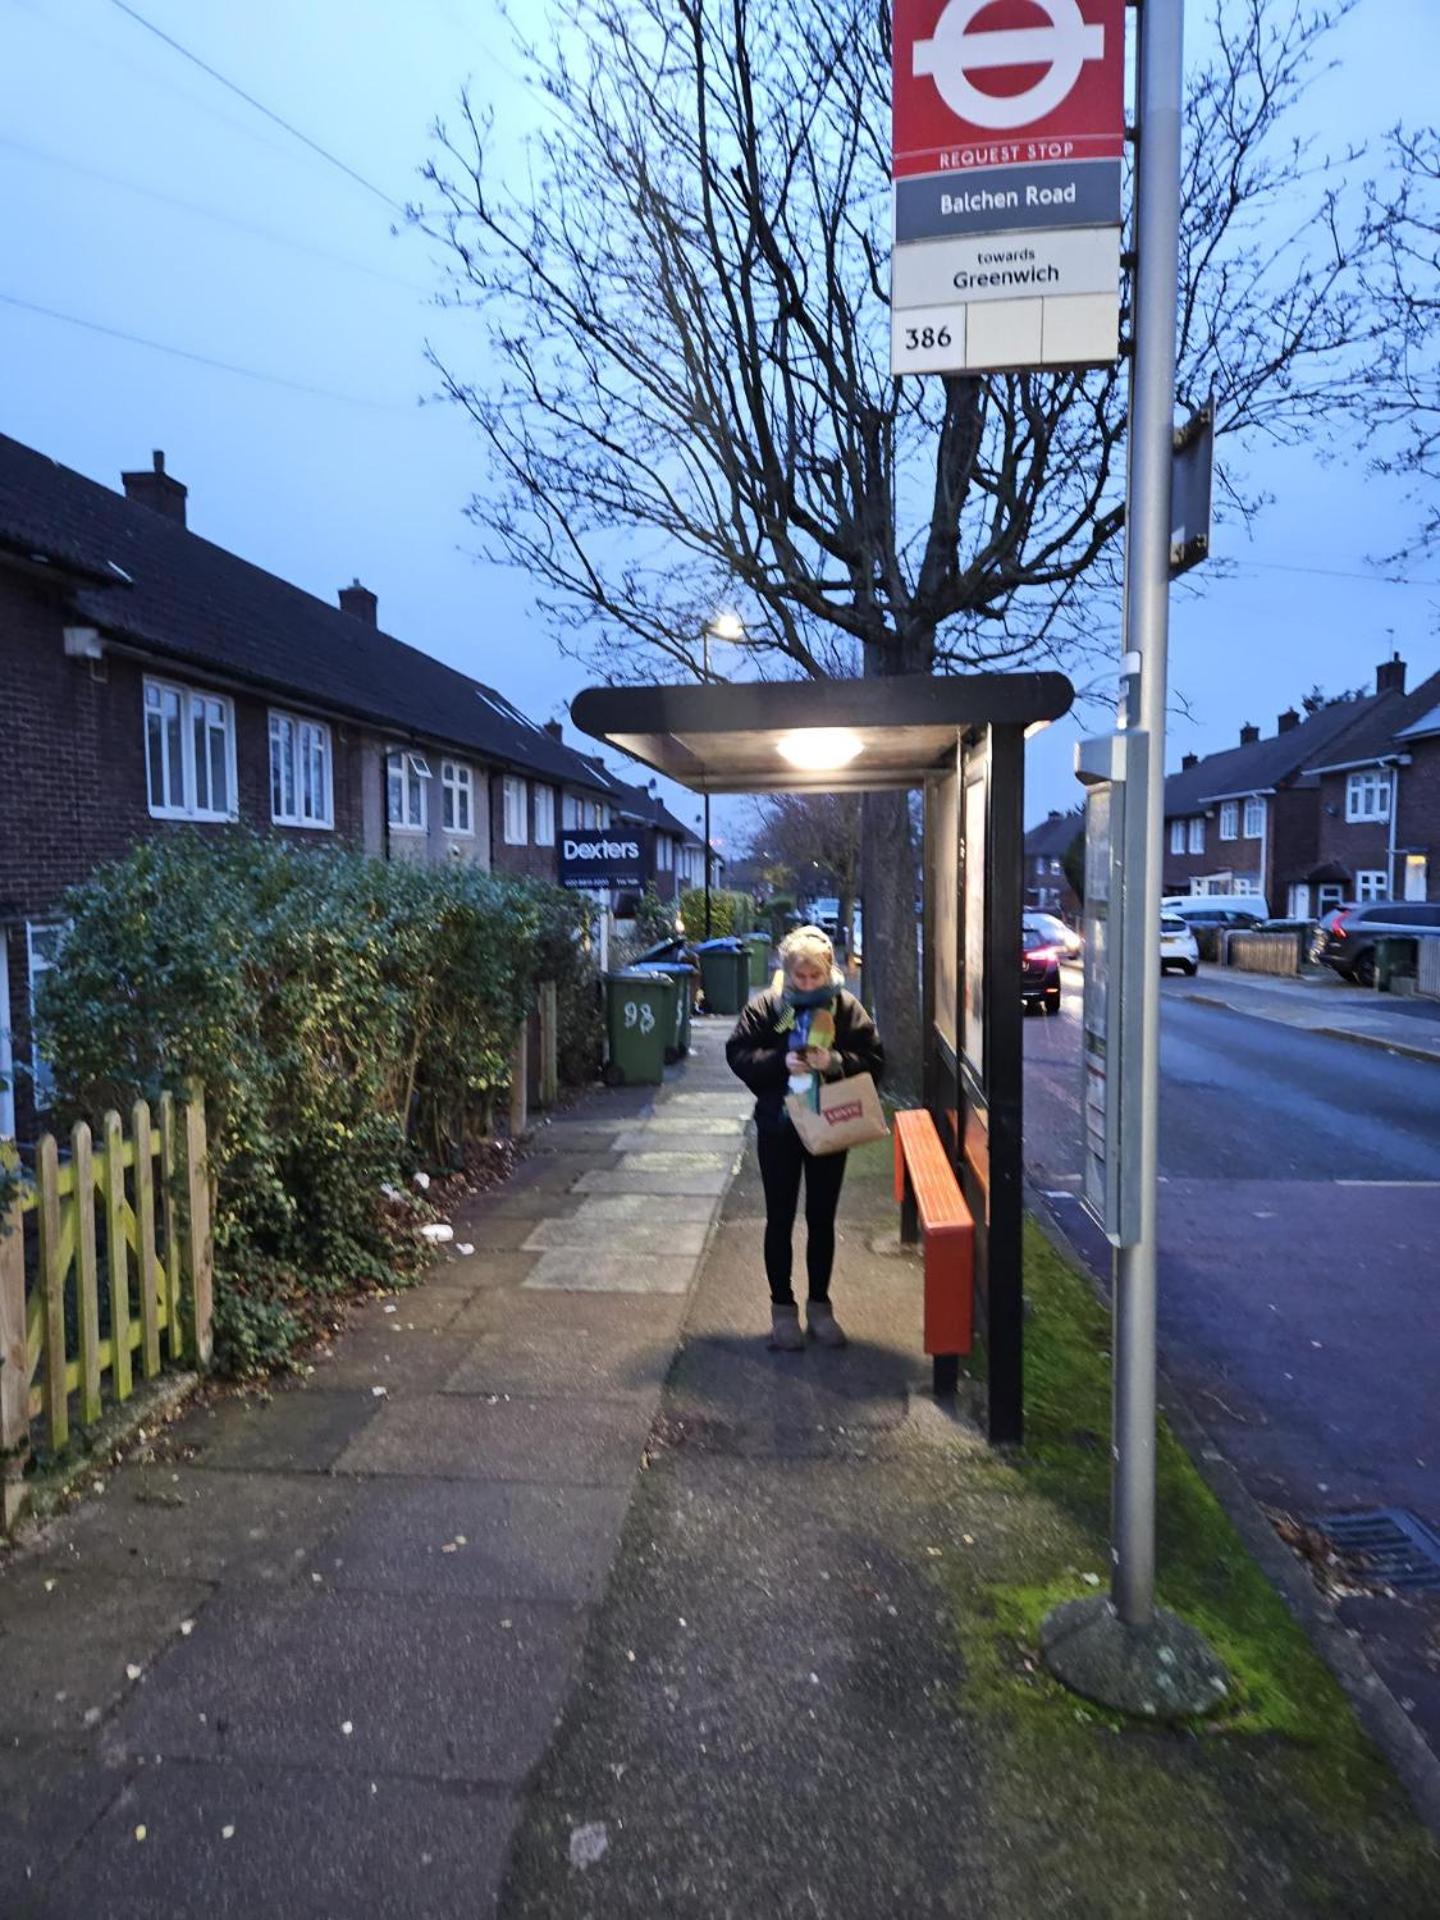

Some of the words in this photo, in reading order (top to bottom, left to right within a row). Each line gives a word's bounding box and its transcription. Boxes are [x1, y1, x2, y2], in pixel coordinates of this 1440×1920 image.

[939, 145, 1020, 169] REQUEST
[1027, 141, 1075, 160] STOP
[940, 190, 1019, 215] Balchen
[1026, 183, 1077, 207] Road
[977, 248, 1036, 266] towards
[953, 265, 1060, 290] Greenwich
[904, 326, 952, 350] 386
[563, 839, 640, 860] Dexters
